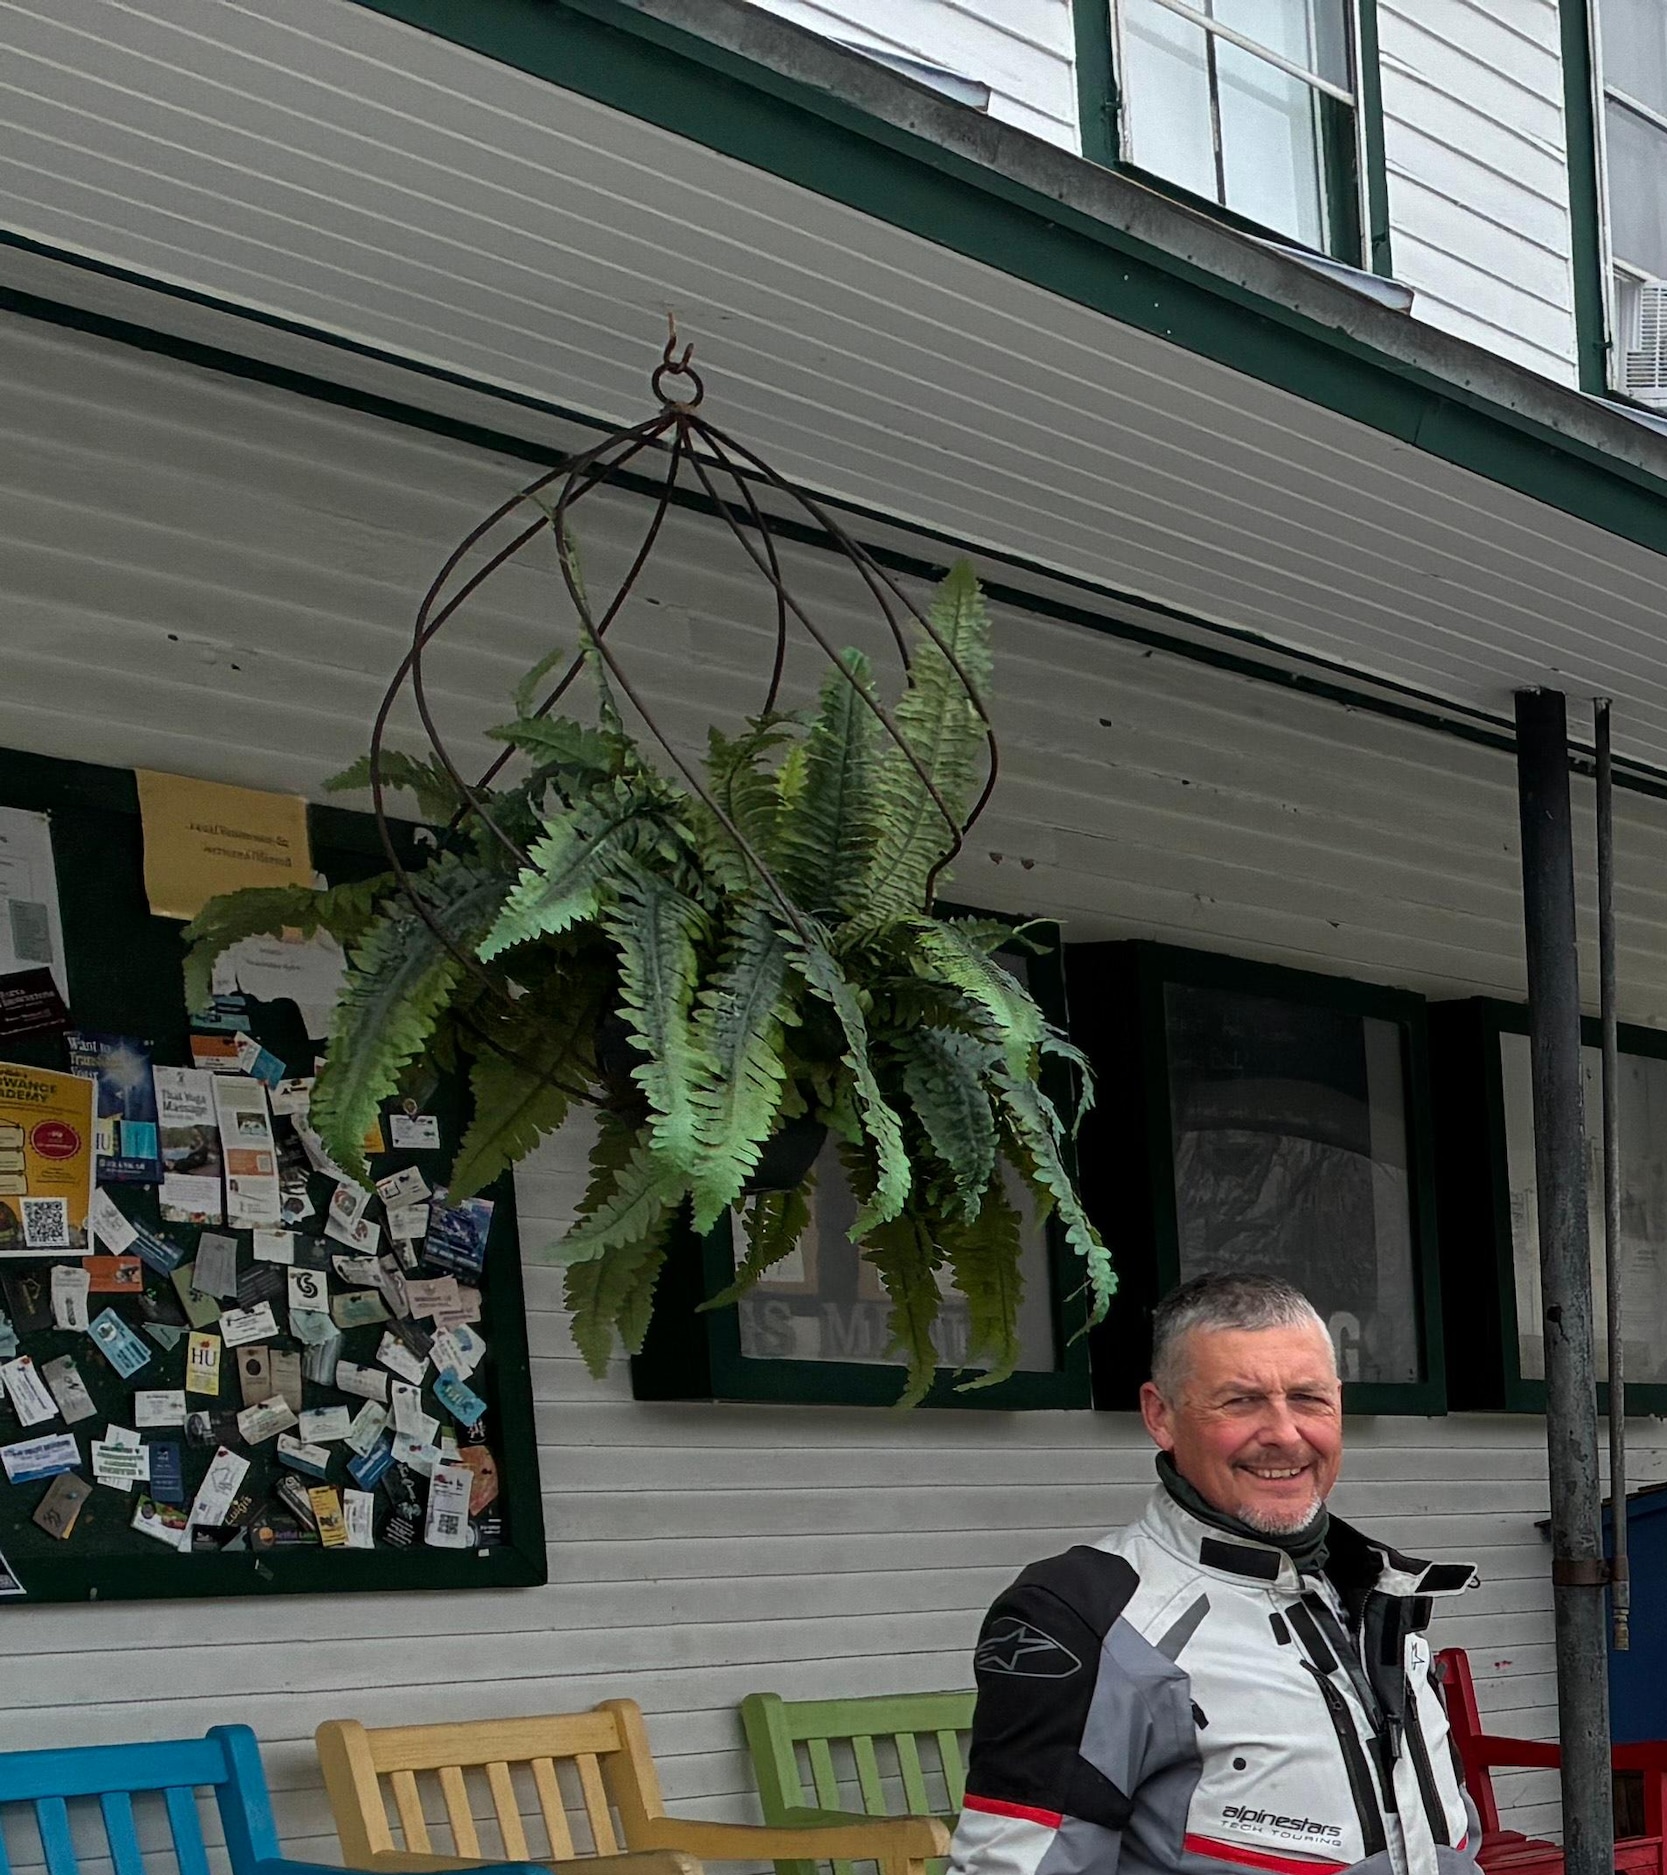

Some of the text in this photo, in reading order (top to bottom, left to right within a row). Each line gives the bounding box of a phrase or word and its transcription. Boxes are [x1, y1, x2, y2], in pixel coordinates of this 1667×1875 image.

[191, 1348, 216, 1366] HU
[1219, 1820, 1343, 1847] TECH TOURING
[1222, 1805, 1342, 1837] alpinestars
